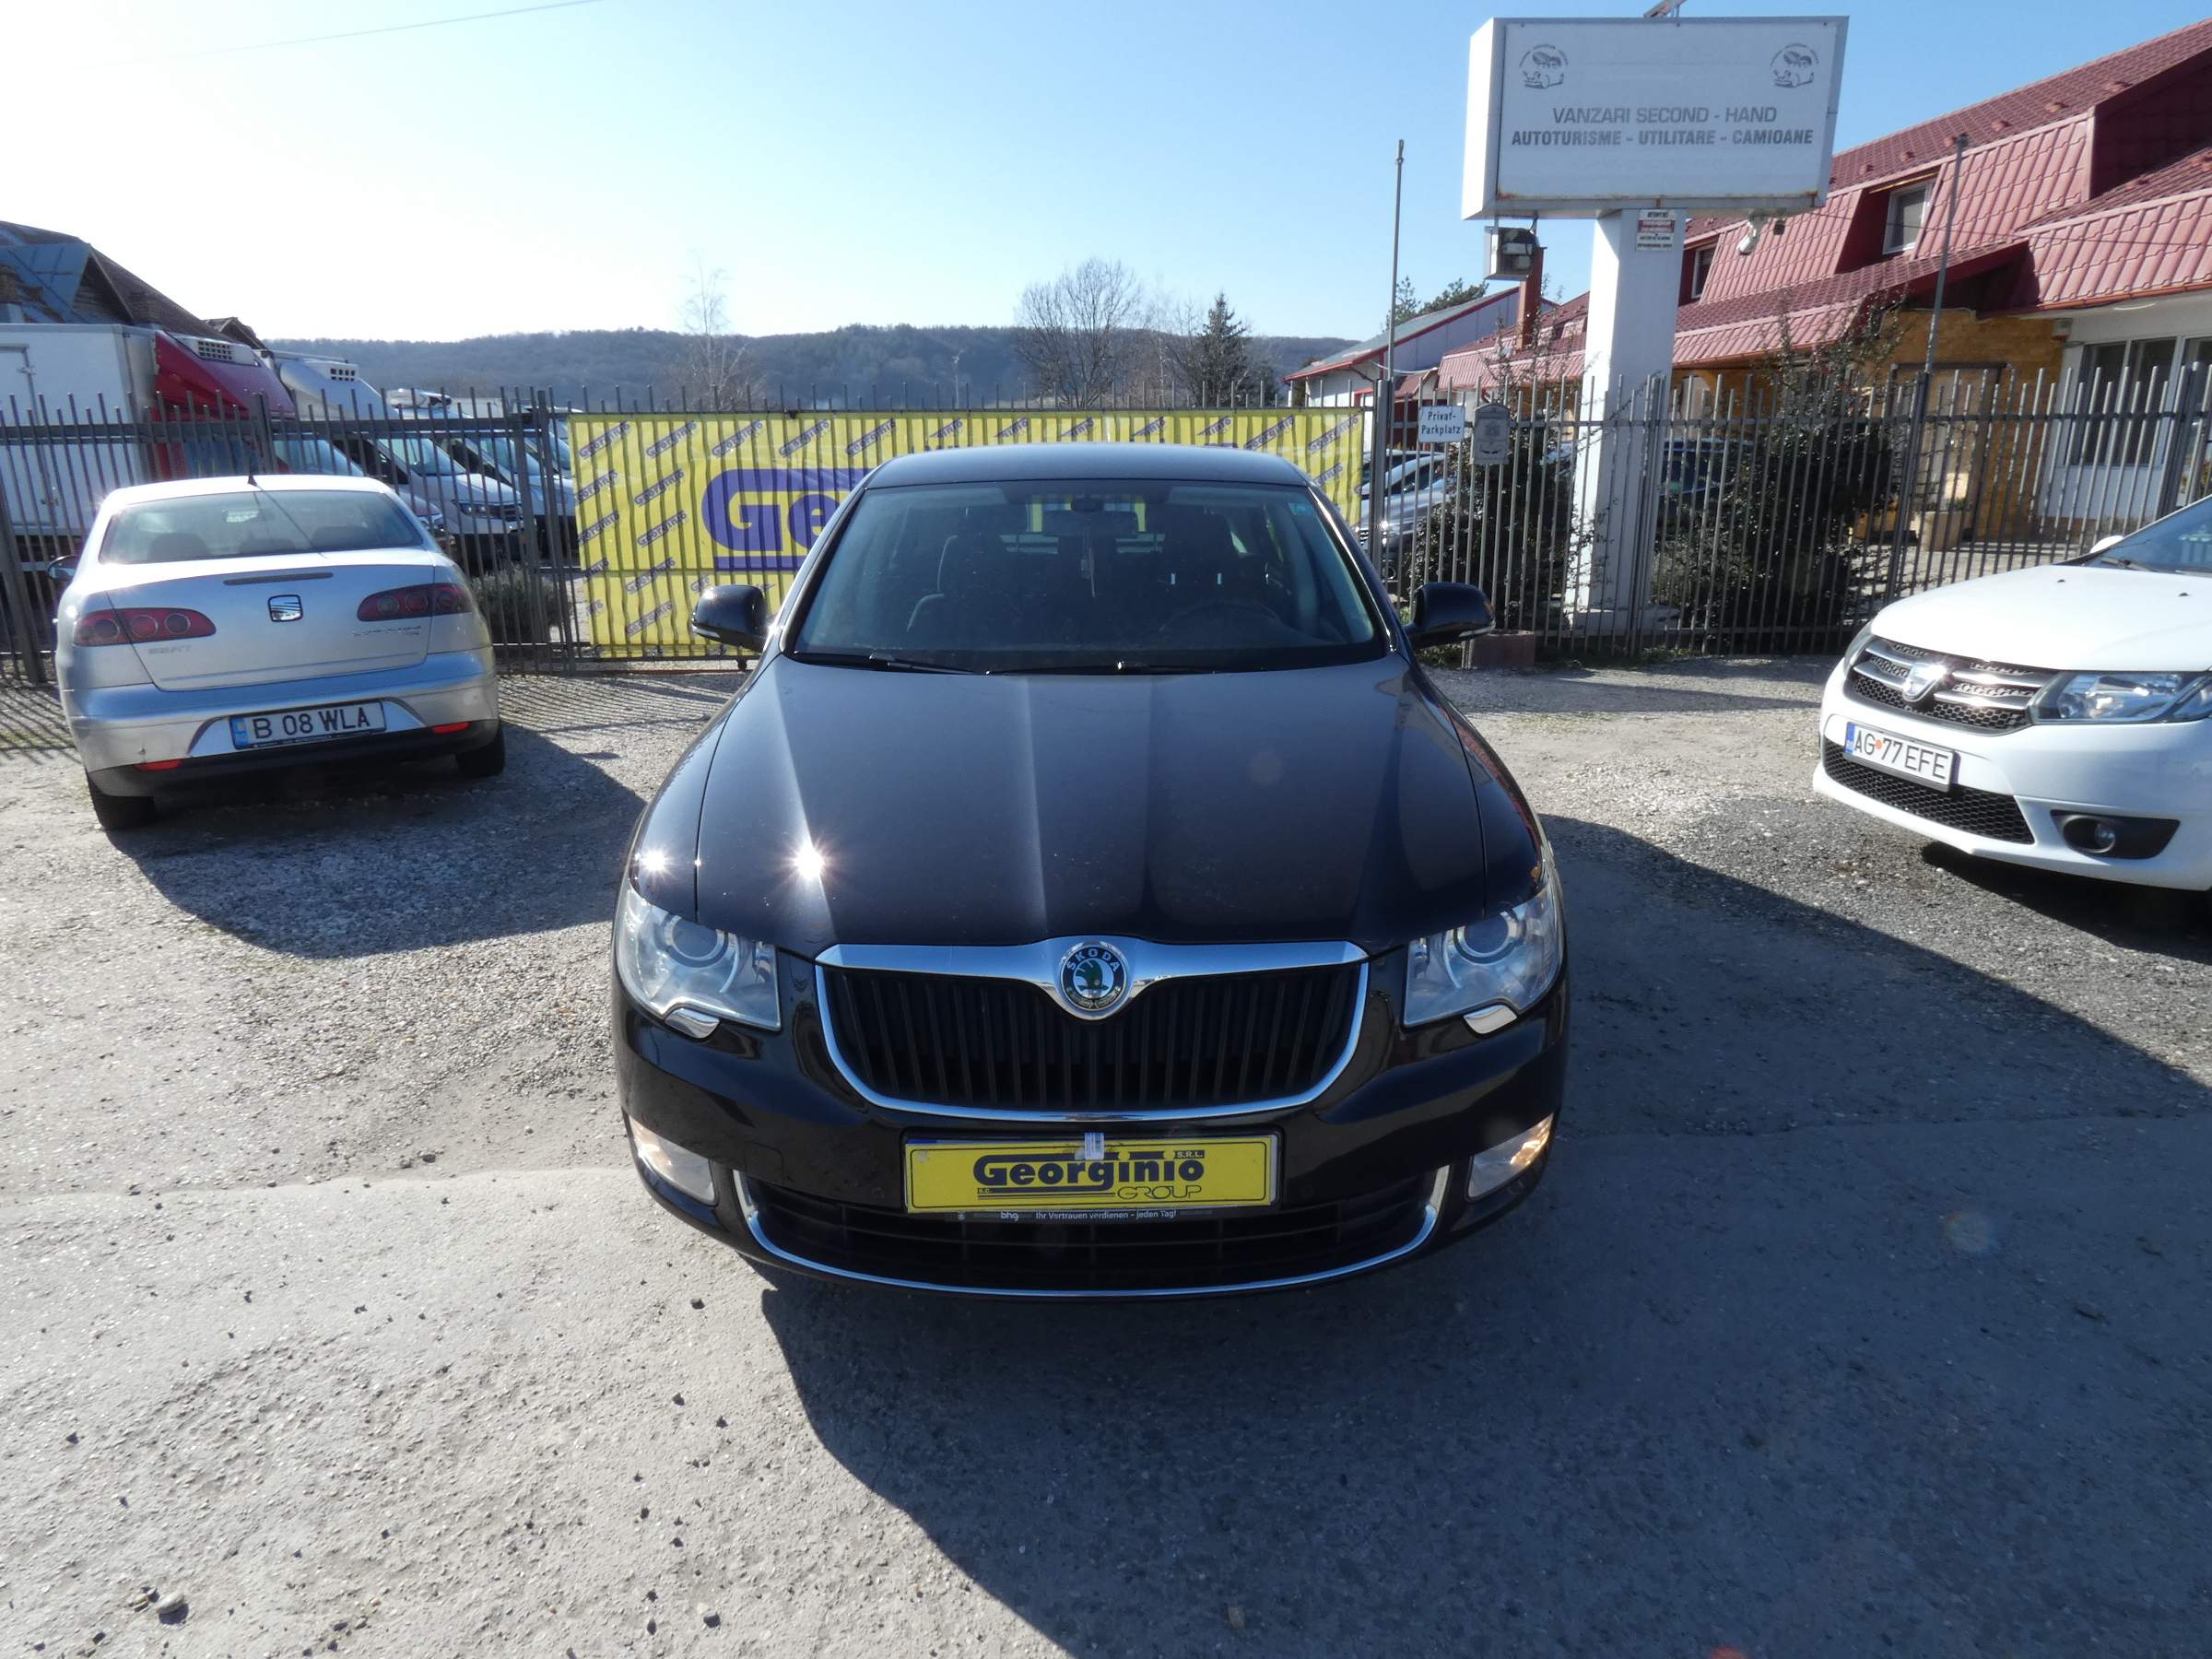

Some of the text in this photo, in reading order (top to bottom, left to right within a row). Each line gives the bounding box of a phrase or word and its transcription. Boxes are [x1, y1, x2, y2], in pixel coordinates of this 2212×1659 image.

[1552, 108, 1630, 124] VANZARI
[1636, 107, 1709, 124] SECOND
[1724, 106, 1777, 123] HAND
[1512, 130, 1621, 146] AUTOTURISME
[1638, 130, 1715, 146] UTILITARE
[1732, 129, 1813, 145] CAMIOANE
[1428, 411, 1456, 421] Privat-
[1421, 424, 1461, 436] Parkplatz
[252, 707, 371, 739] B 08 WLA
[1854, 729, 1949, 780] AG 77 EFE
[973, 1150, 1205, 1194] Georginio
[1117, 1185, 1202, 1200] GROUP
[1001, 1210, 1019, 1221] bhg
